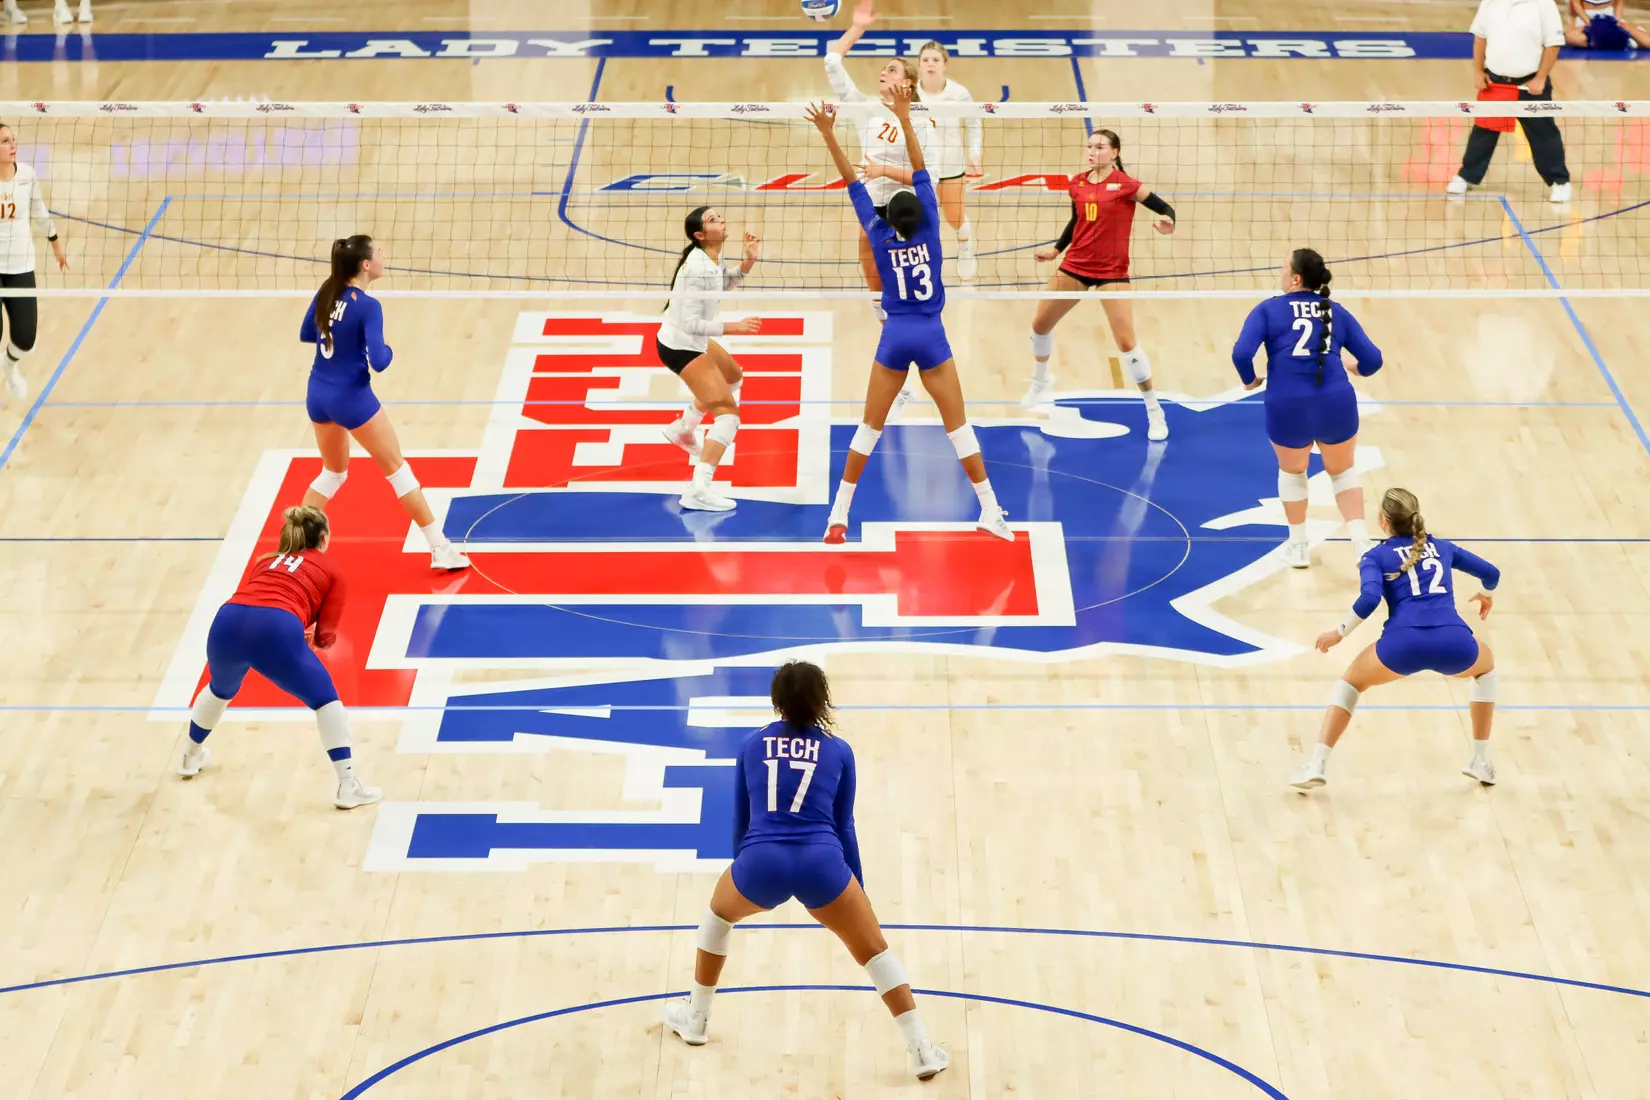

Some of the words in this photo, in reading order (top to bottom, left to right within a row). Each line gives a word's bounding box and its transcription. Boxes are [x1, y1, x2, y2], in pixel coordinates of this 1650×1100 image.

[264, 39, 613, 58] LADY
[649, 38, 1416, 59] TECHSTERS
[877, 122, 899, 143] 20
[597, 173, 1071, 190] CUA
[1, 202, 16, 219] 12
[1085, 202, 1098, 222] 10
[887, 243, 930, 268] TECH
[892, 263, 933, 301] 13
[268, 553, 305, 573] 14
[1405, 557, 1448, 596] 12
[762, 736, 820, 762] TECH
[762, 759, 818, 813] 17
